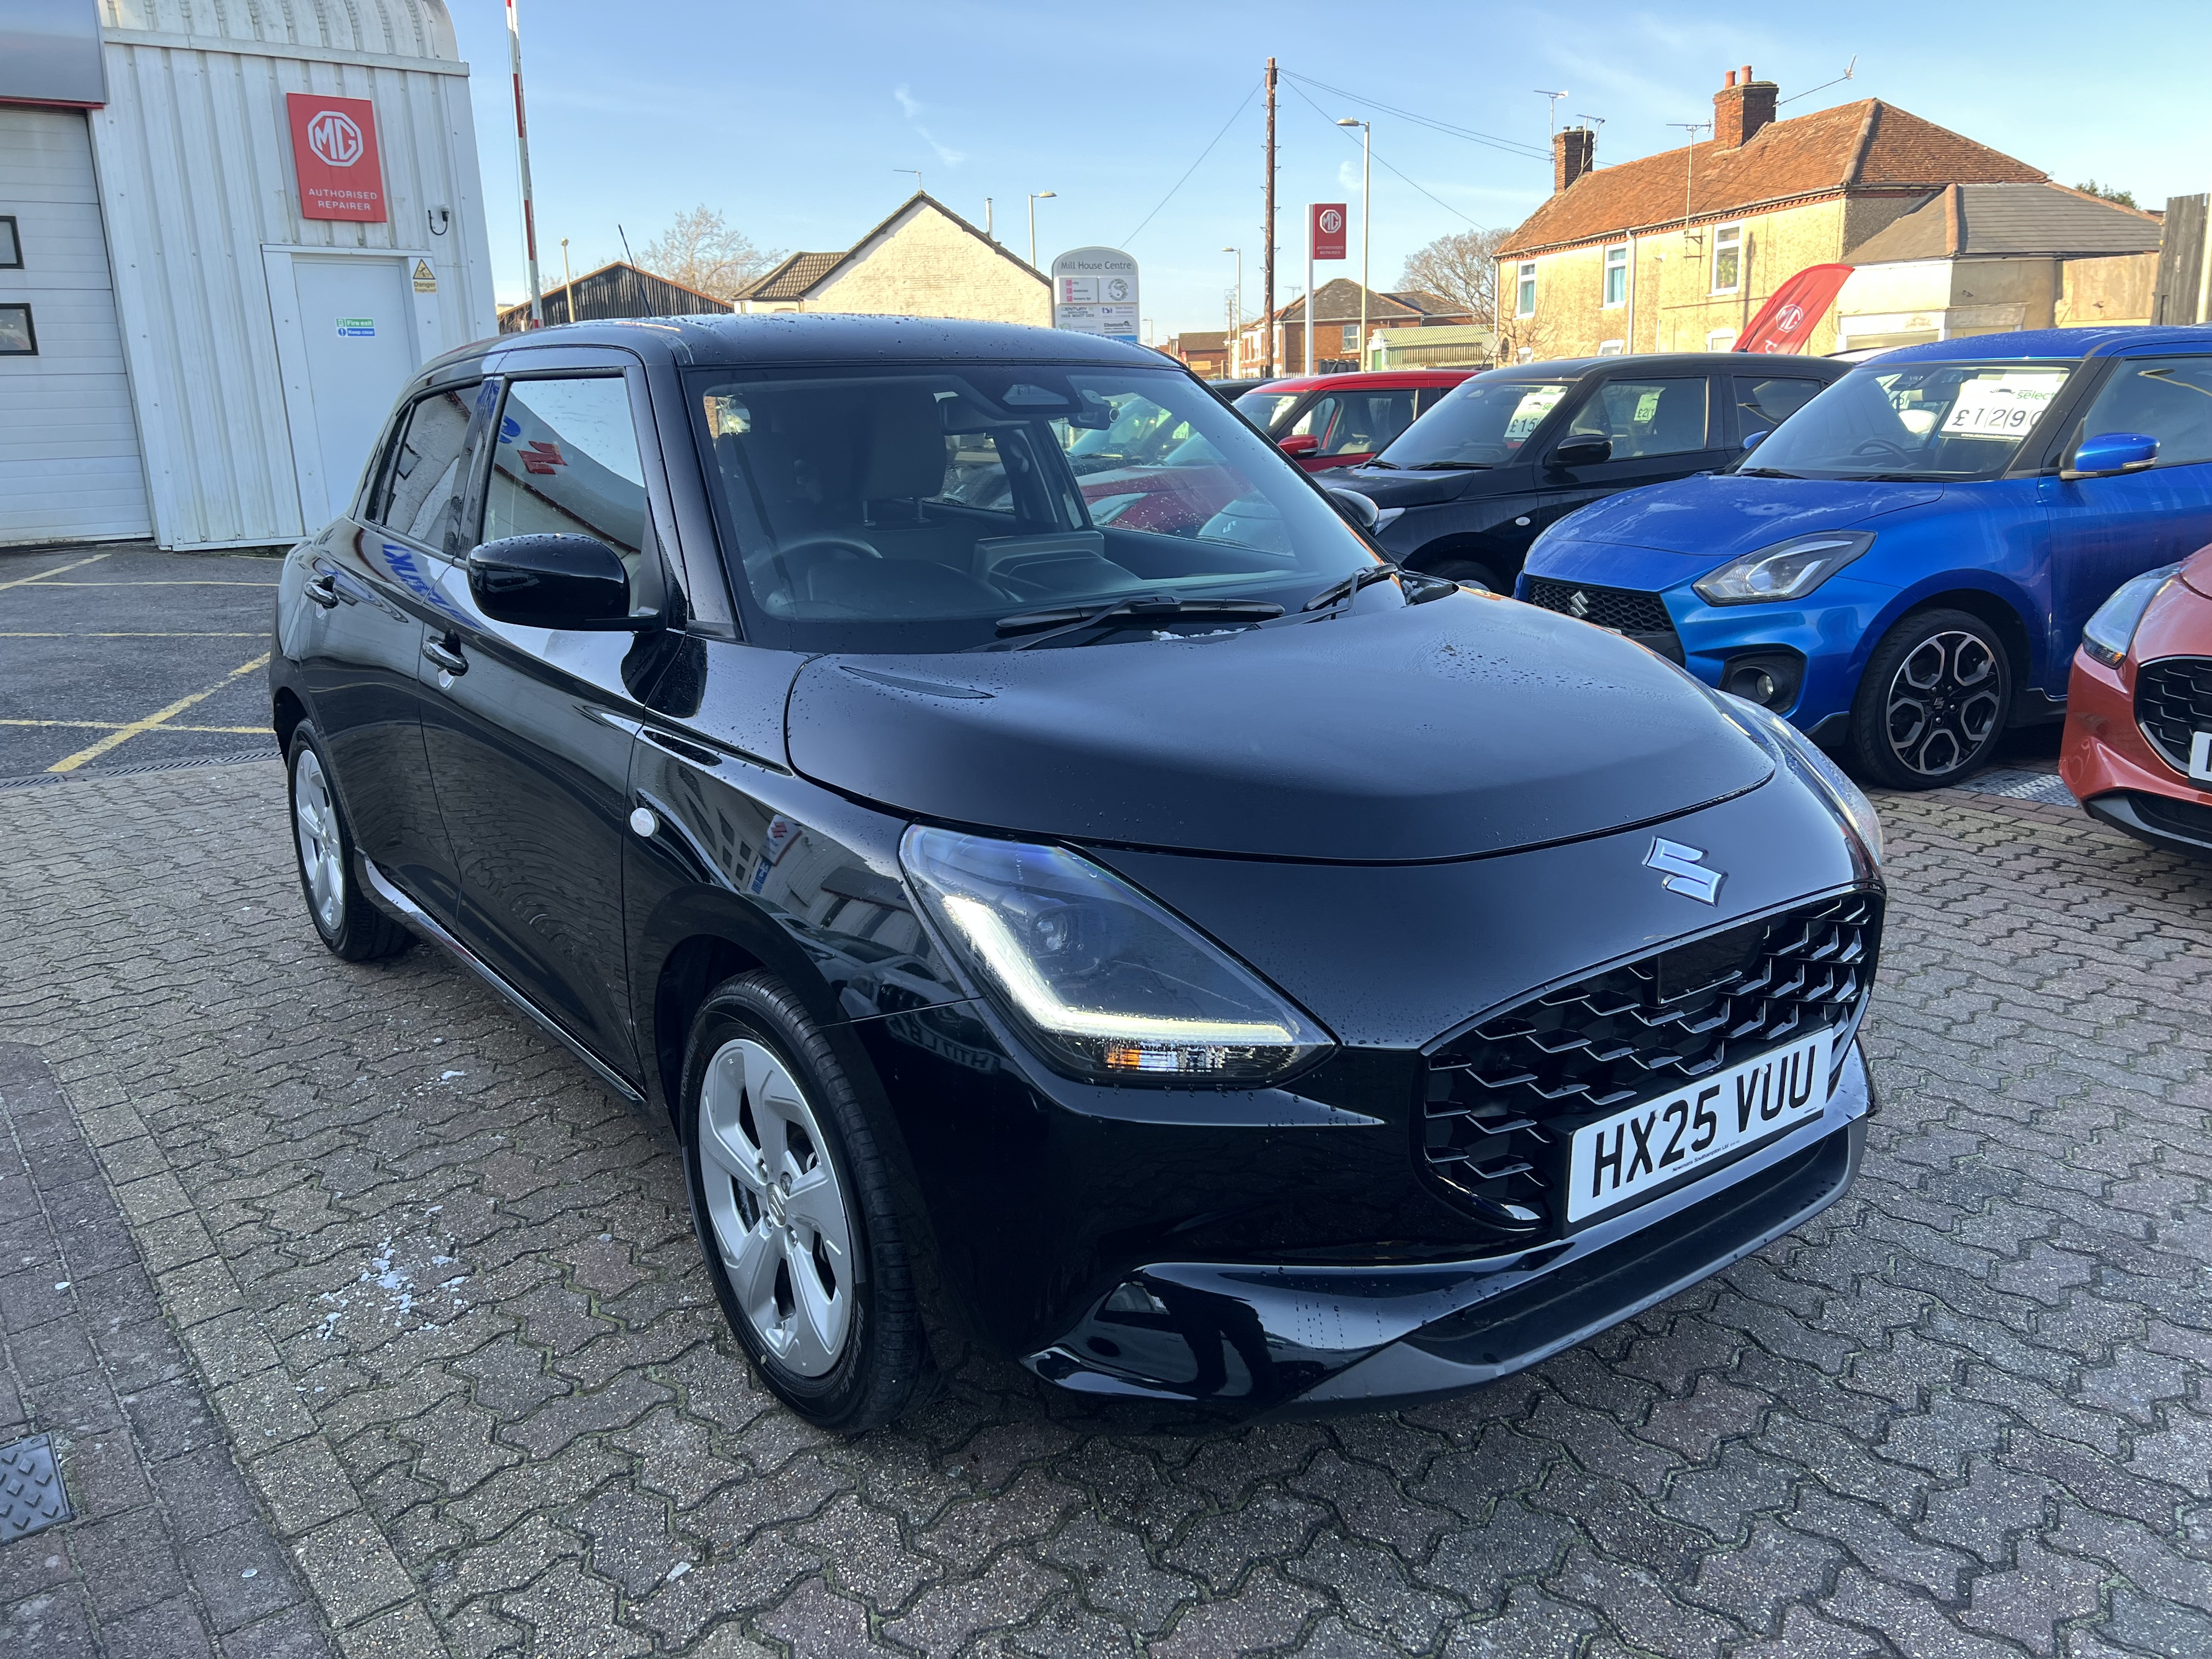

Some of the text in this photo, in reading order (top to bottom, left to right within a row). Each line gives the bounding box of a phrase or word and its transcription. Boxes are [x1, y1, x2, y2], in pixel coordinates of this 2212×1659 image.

[314, 118, 357, 160] MG
[309, 189, 377, 200] AUTHORISED
[318, 200, 370, 211] REPAIRER
[1323, 212, 1340, 230] MG
[1779, 307, 1802, 330] MG
[1593, 1046, 1816, 1198] HX25 VUU
[1694, 1148, 1722, 1163] Southampton
